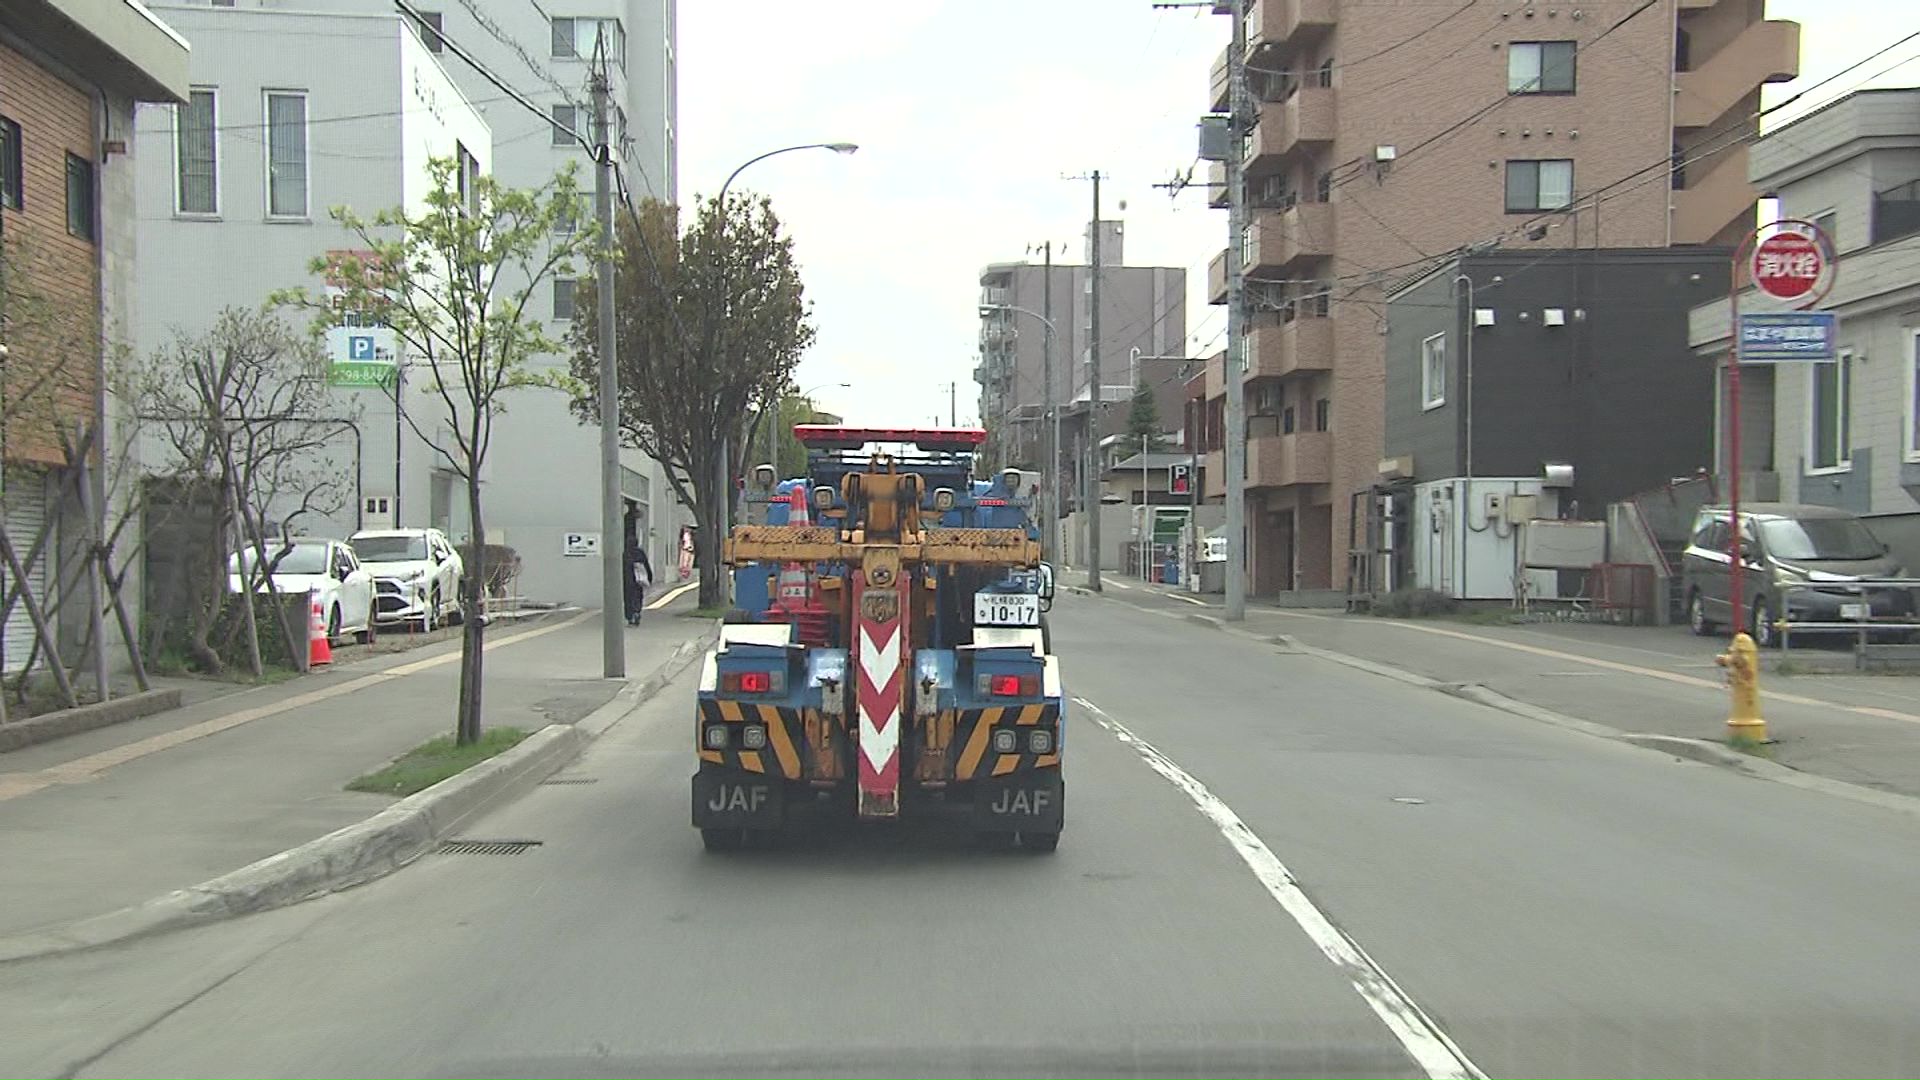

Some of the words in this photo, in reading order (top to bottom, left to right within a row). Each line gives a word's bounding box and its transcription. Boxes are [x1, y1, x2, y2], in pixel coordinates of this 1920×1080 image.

[1758, 252, 1818, 277] 消火栓
[355, 339, 369, 358] P
[1175, 466, 1187, 480] P
[568, 535, 582, 546] P
[991, 606, 1035, 622] 10-17
[709, 784, 768, 812] JAF
[991, 788, 1050, 815] JAF
